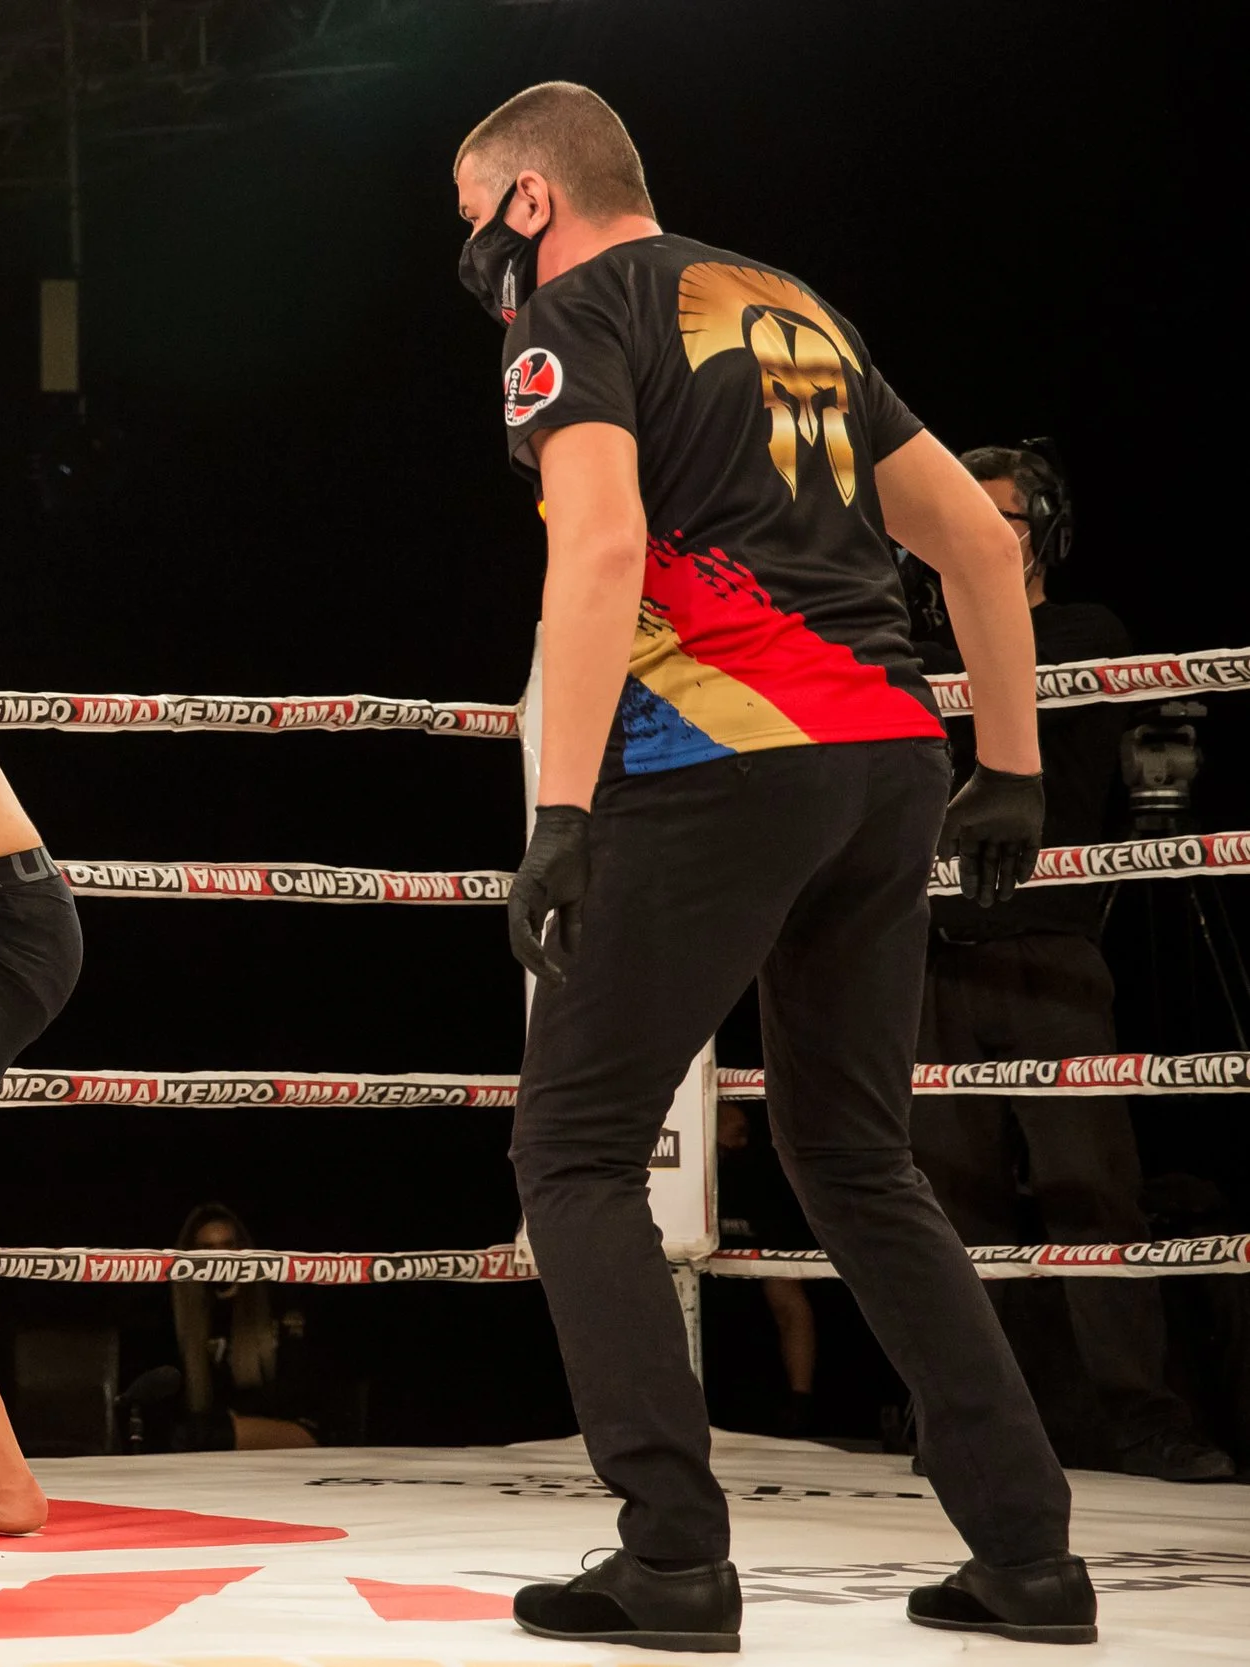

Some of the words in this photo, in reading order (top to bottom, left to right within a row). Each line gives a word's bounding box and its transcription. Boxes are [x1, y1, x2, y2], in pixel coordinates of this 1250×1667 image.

[1036, 670, 1099, 697] MPO
[1105, 664, 1187, 692] MMA
[82, 701, 152, 724] MMA
[165, 700, 272, 727] KEMPO
[278, 703, 345, 727] MMA
[359, 702, 458, 730] KEMPO
[463, 713, 509, 735] MM
[1034, 851, 1081, 878] MA
[1090, 839, 1202, 874] KEMPO
[68, 865, 180, 889] KEMPO
[188, 867, 263, 892] MMA
[270, 871, 377, 897] KEMPO
[383, 874, 455, 898] MMA
[912, 1063, 945, 1085] MA
[955, 1060, 1056, 1084] KEMPO
[1065, 1057, 1137, 1083] MMA
[1153, 1056, 1250, 1084] KEMP
[77, 1080, 151, 1103] MMA
[165, 1083, 275, 1103] KEMPO
[281, 1084, 349, 1104] MMA
[362, 1086, 466, 1106] KEMPO
[472, 1089, 518, 1107] MM
[1126, 1236, 1239, 1263] KEMPO
[88, 1259, 162, 1282] MMA
[171, 1257, 280, 1281] KEMPO
[293, 1259, 362, 1282] MMA
[372, 1255, 479, 1281] KEMPO
